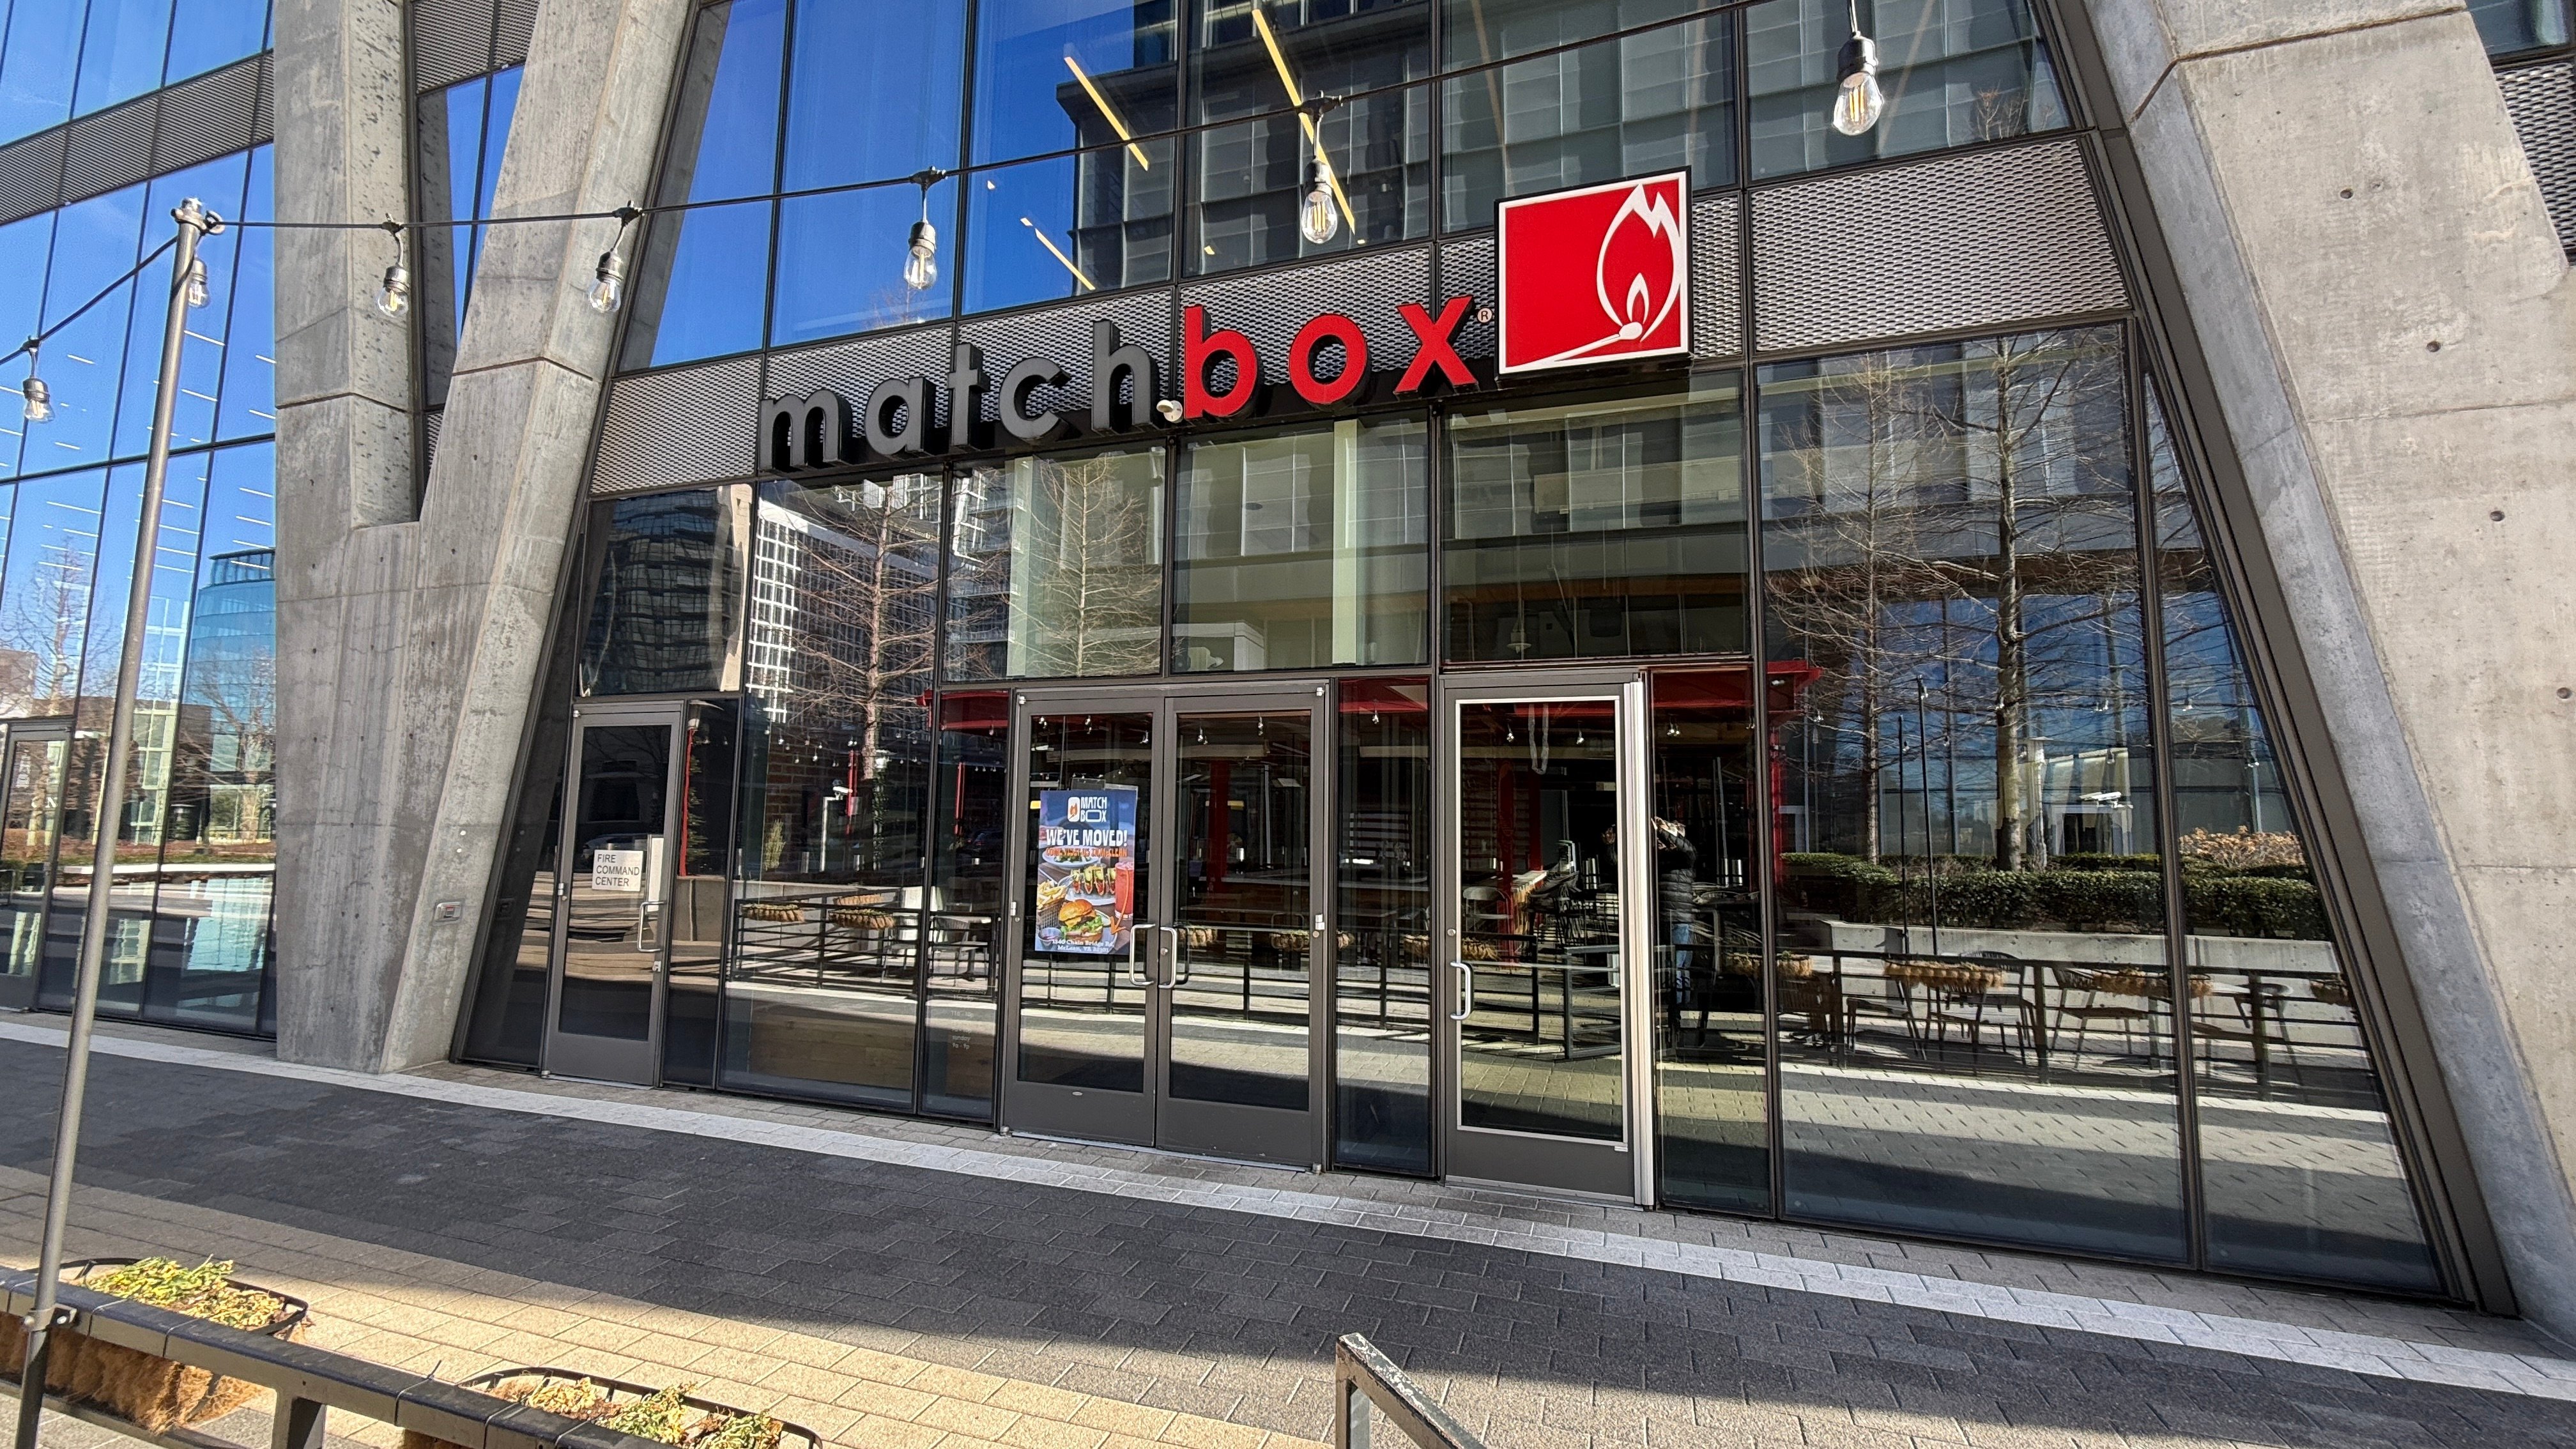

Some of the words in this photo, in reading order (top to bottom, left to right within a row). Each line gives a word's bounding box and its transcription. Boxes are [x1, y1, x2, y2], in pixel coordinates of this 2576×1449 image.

[762, 295, 1478, 468] matchbox
[1080, 796, 1107, 809] MATCH
[1080, 809, 1107, 822] BOX
[1046, 829, 1080, 846] WE'VE
[1082, 829, 1128, 847] MOVED!
[597, 854, 617, 863] FIRE
[596, 865, 640, 876] COMMAND
[595, 877, 629, 887] CENTER
